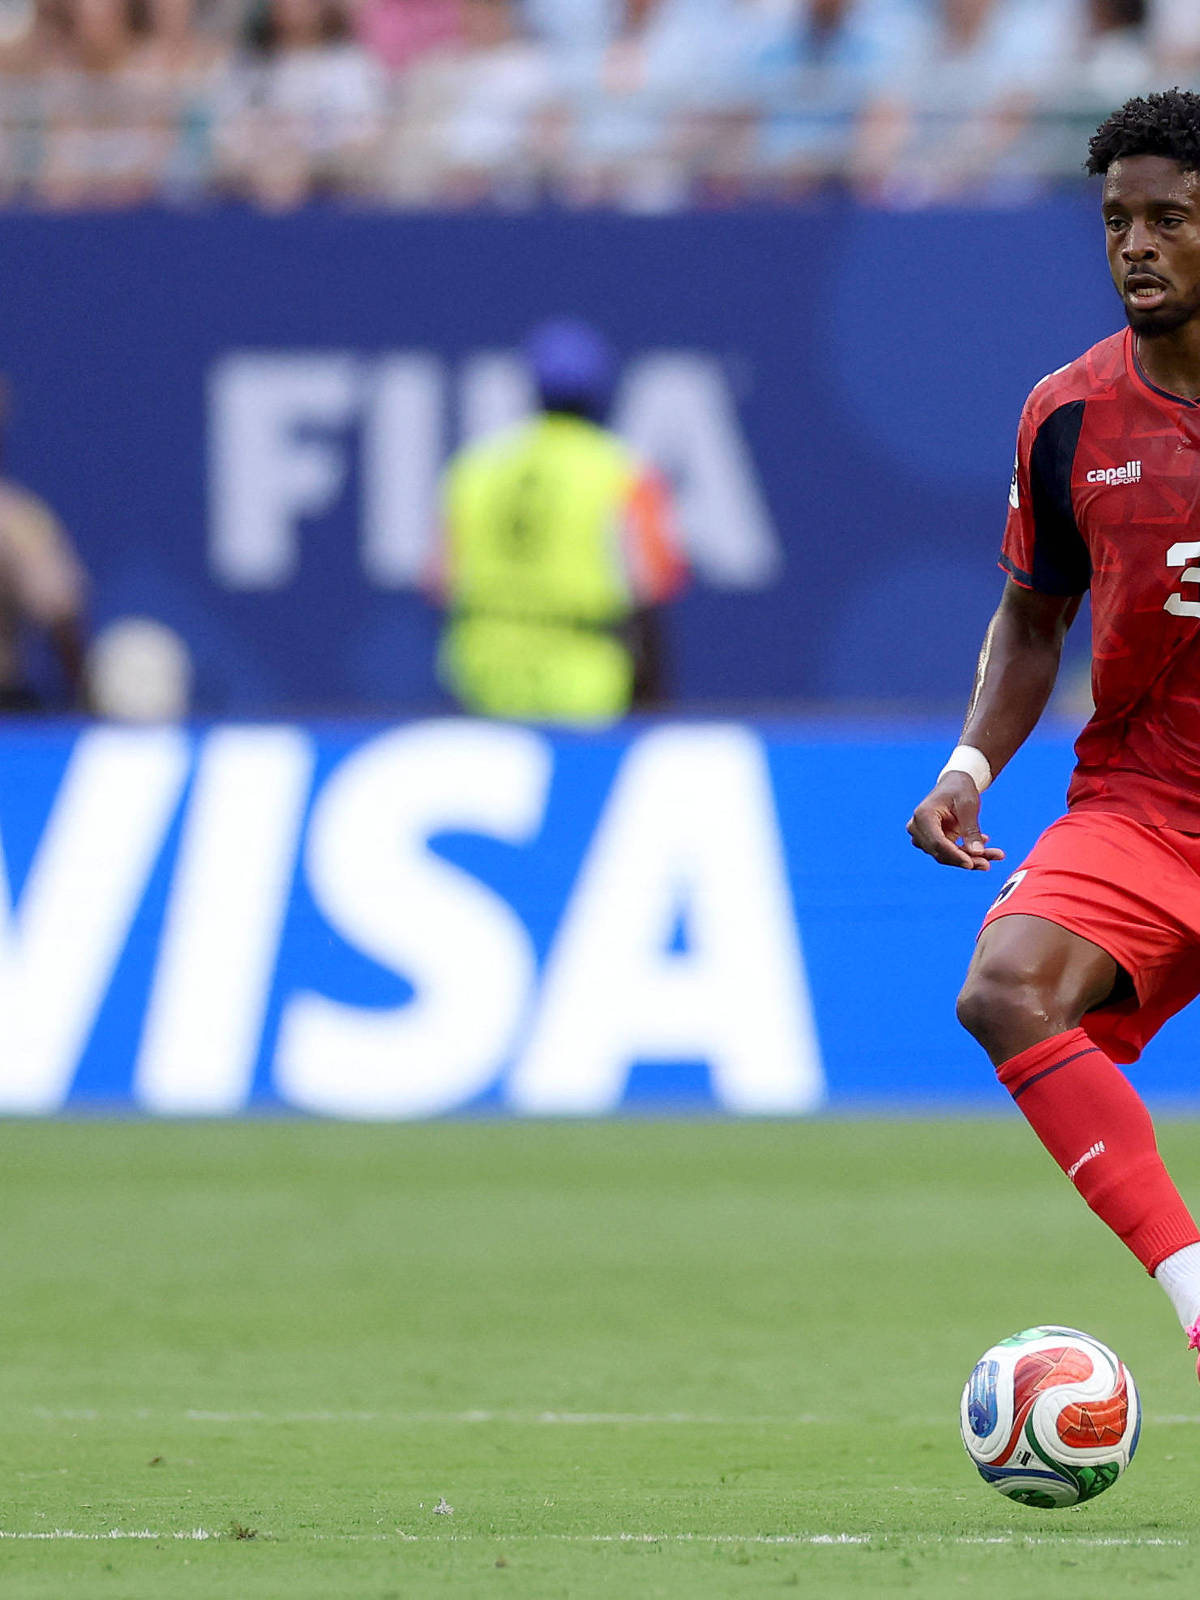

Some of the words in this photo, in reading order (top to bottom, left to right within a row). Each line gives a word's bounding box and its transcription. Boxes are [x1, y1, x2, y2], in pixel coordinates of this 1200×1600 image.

[209, 349, 779, 590] FIA
[1086, 460, 1141, 485] capelli
[1111, 477, 1141, 486] SPORT
